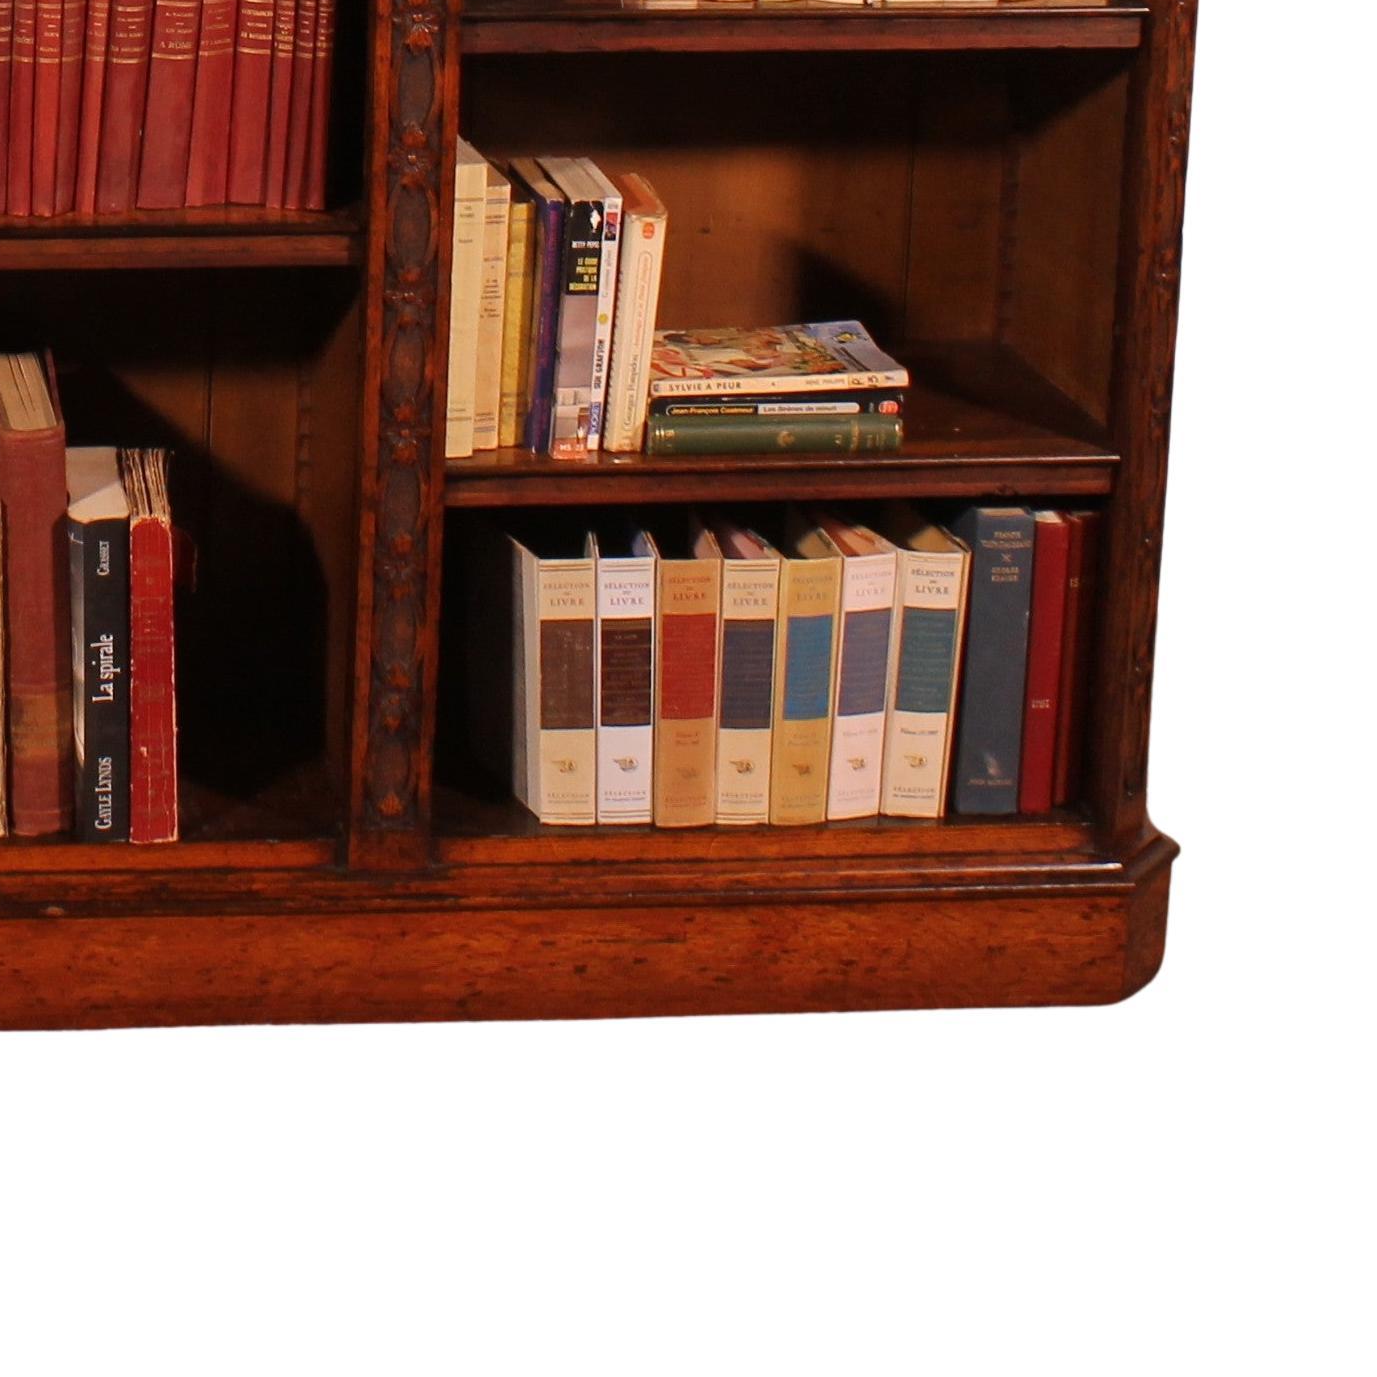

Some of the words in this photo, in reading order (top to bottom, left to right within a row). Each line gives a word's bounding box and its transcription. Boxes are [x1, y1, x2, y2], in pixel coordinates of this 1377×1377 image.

[594, 338, 606, 374] GRAFTON
[592, 376, 602, 390] SUE
[668, 382, 703, 393] SYLVIE
[705, 382, 712, 391] A
[716, 380, 742, 391] PEUR
[914, 585, 951, 596] LIVRE
[549, 597, 586, 608] LIVRE
[609, 596, 647, 607] LIVRE
[732, 597, 770, 608] LIVRE
[89, 633, 122, 681] spirale
[90, 682, 115, 703] La
[93, 757, 114, 793] LYNDS
[93, 795, 114, 830] GAYLE
